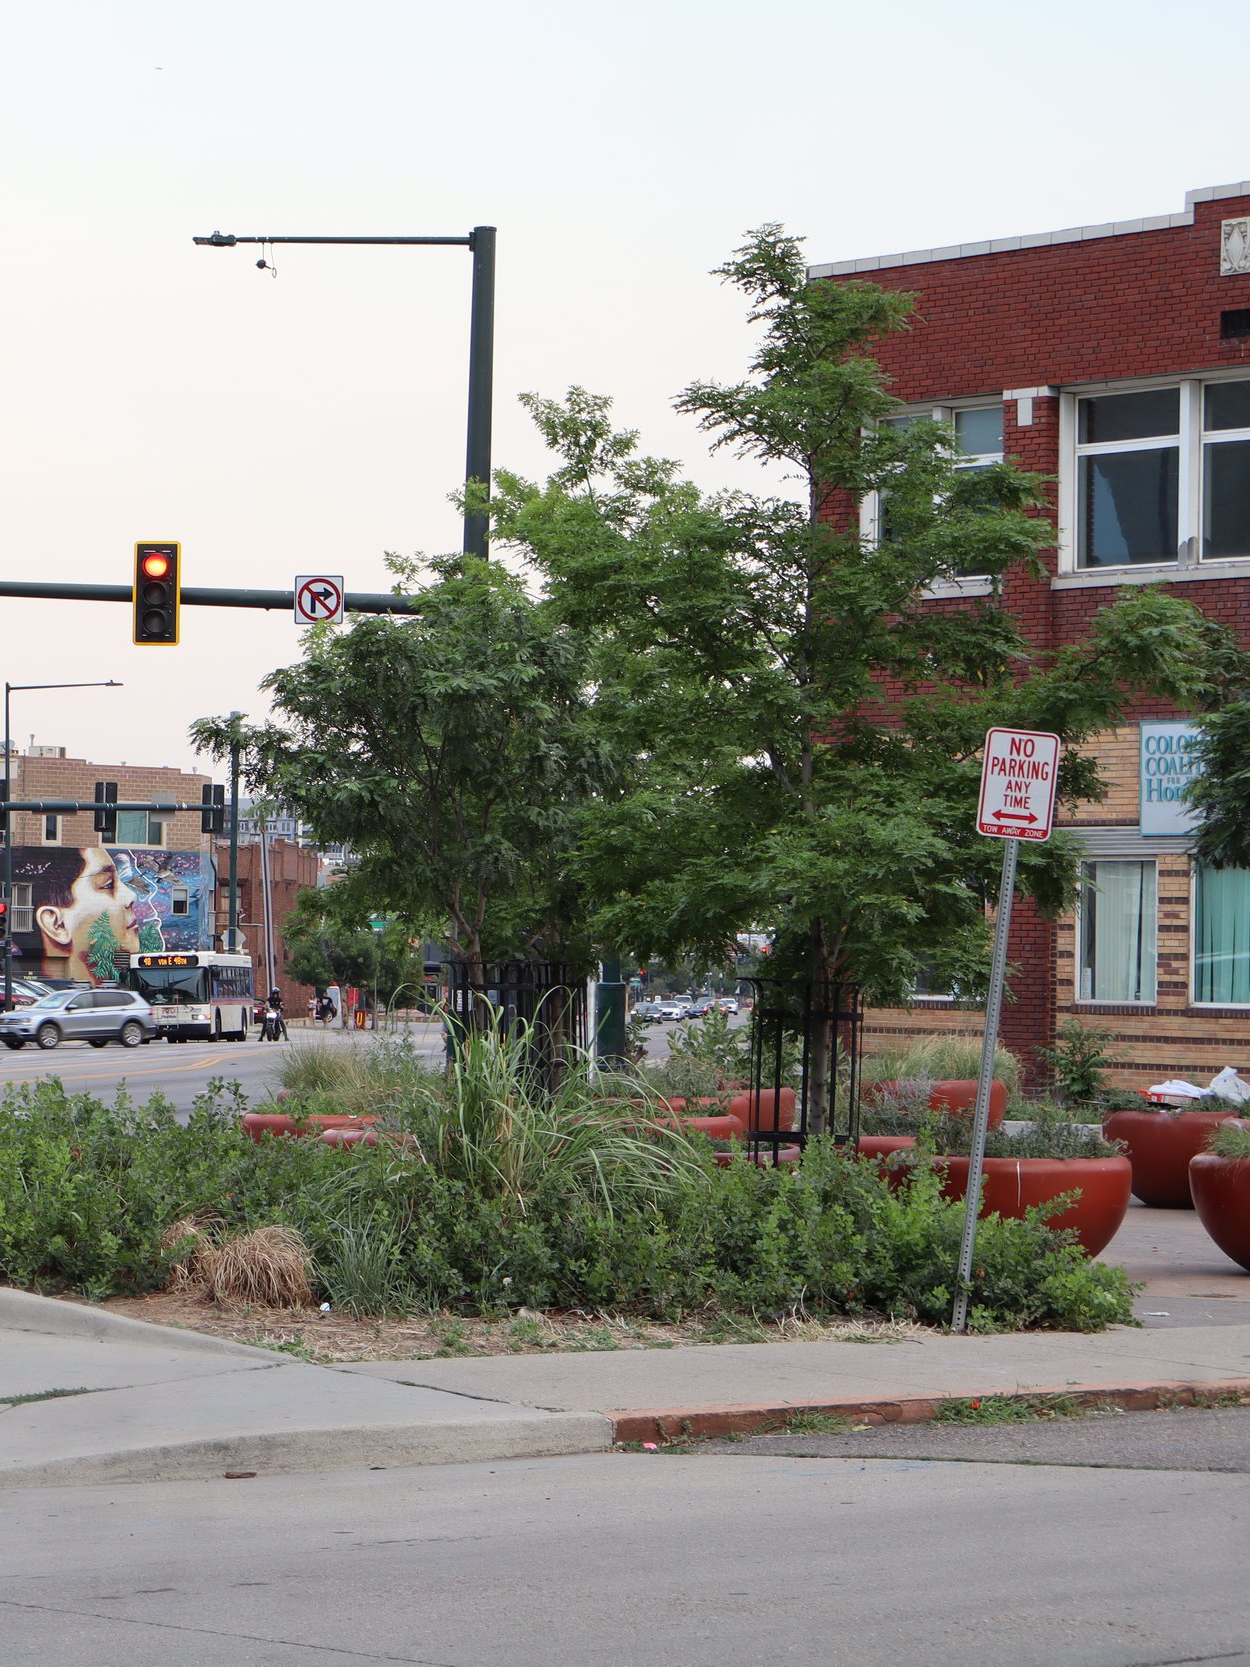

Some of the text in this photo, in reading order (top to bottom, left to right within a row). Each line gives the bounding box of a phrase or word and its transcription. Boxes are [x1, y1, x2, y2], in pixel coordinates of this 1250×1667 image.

[1010, 737, 1035, 758] NO
[991, 756, 1050, 781] PARKING
[1005, 779, 1031, 794] ANY
[1167, 777, 1180, 785] FOR
[1003, 794, 1031, 810] TIME
[983, 824, 1044, 838] TOW AWAY ZONE
[168, 956, 173, 965] E
